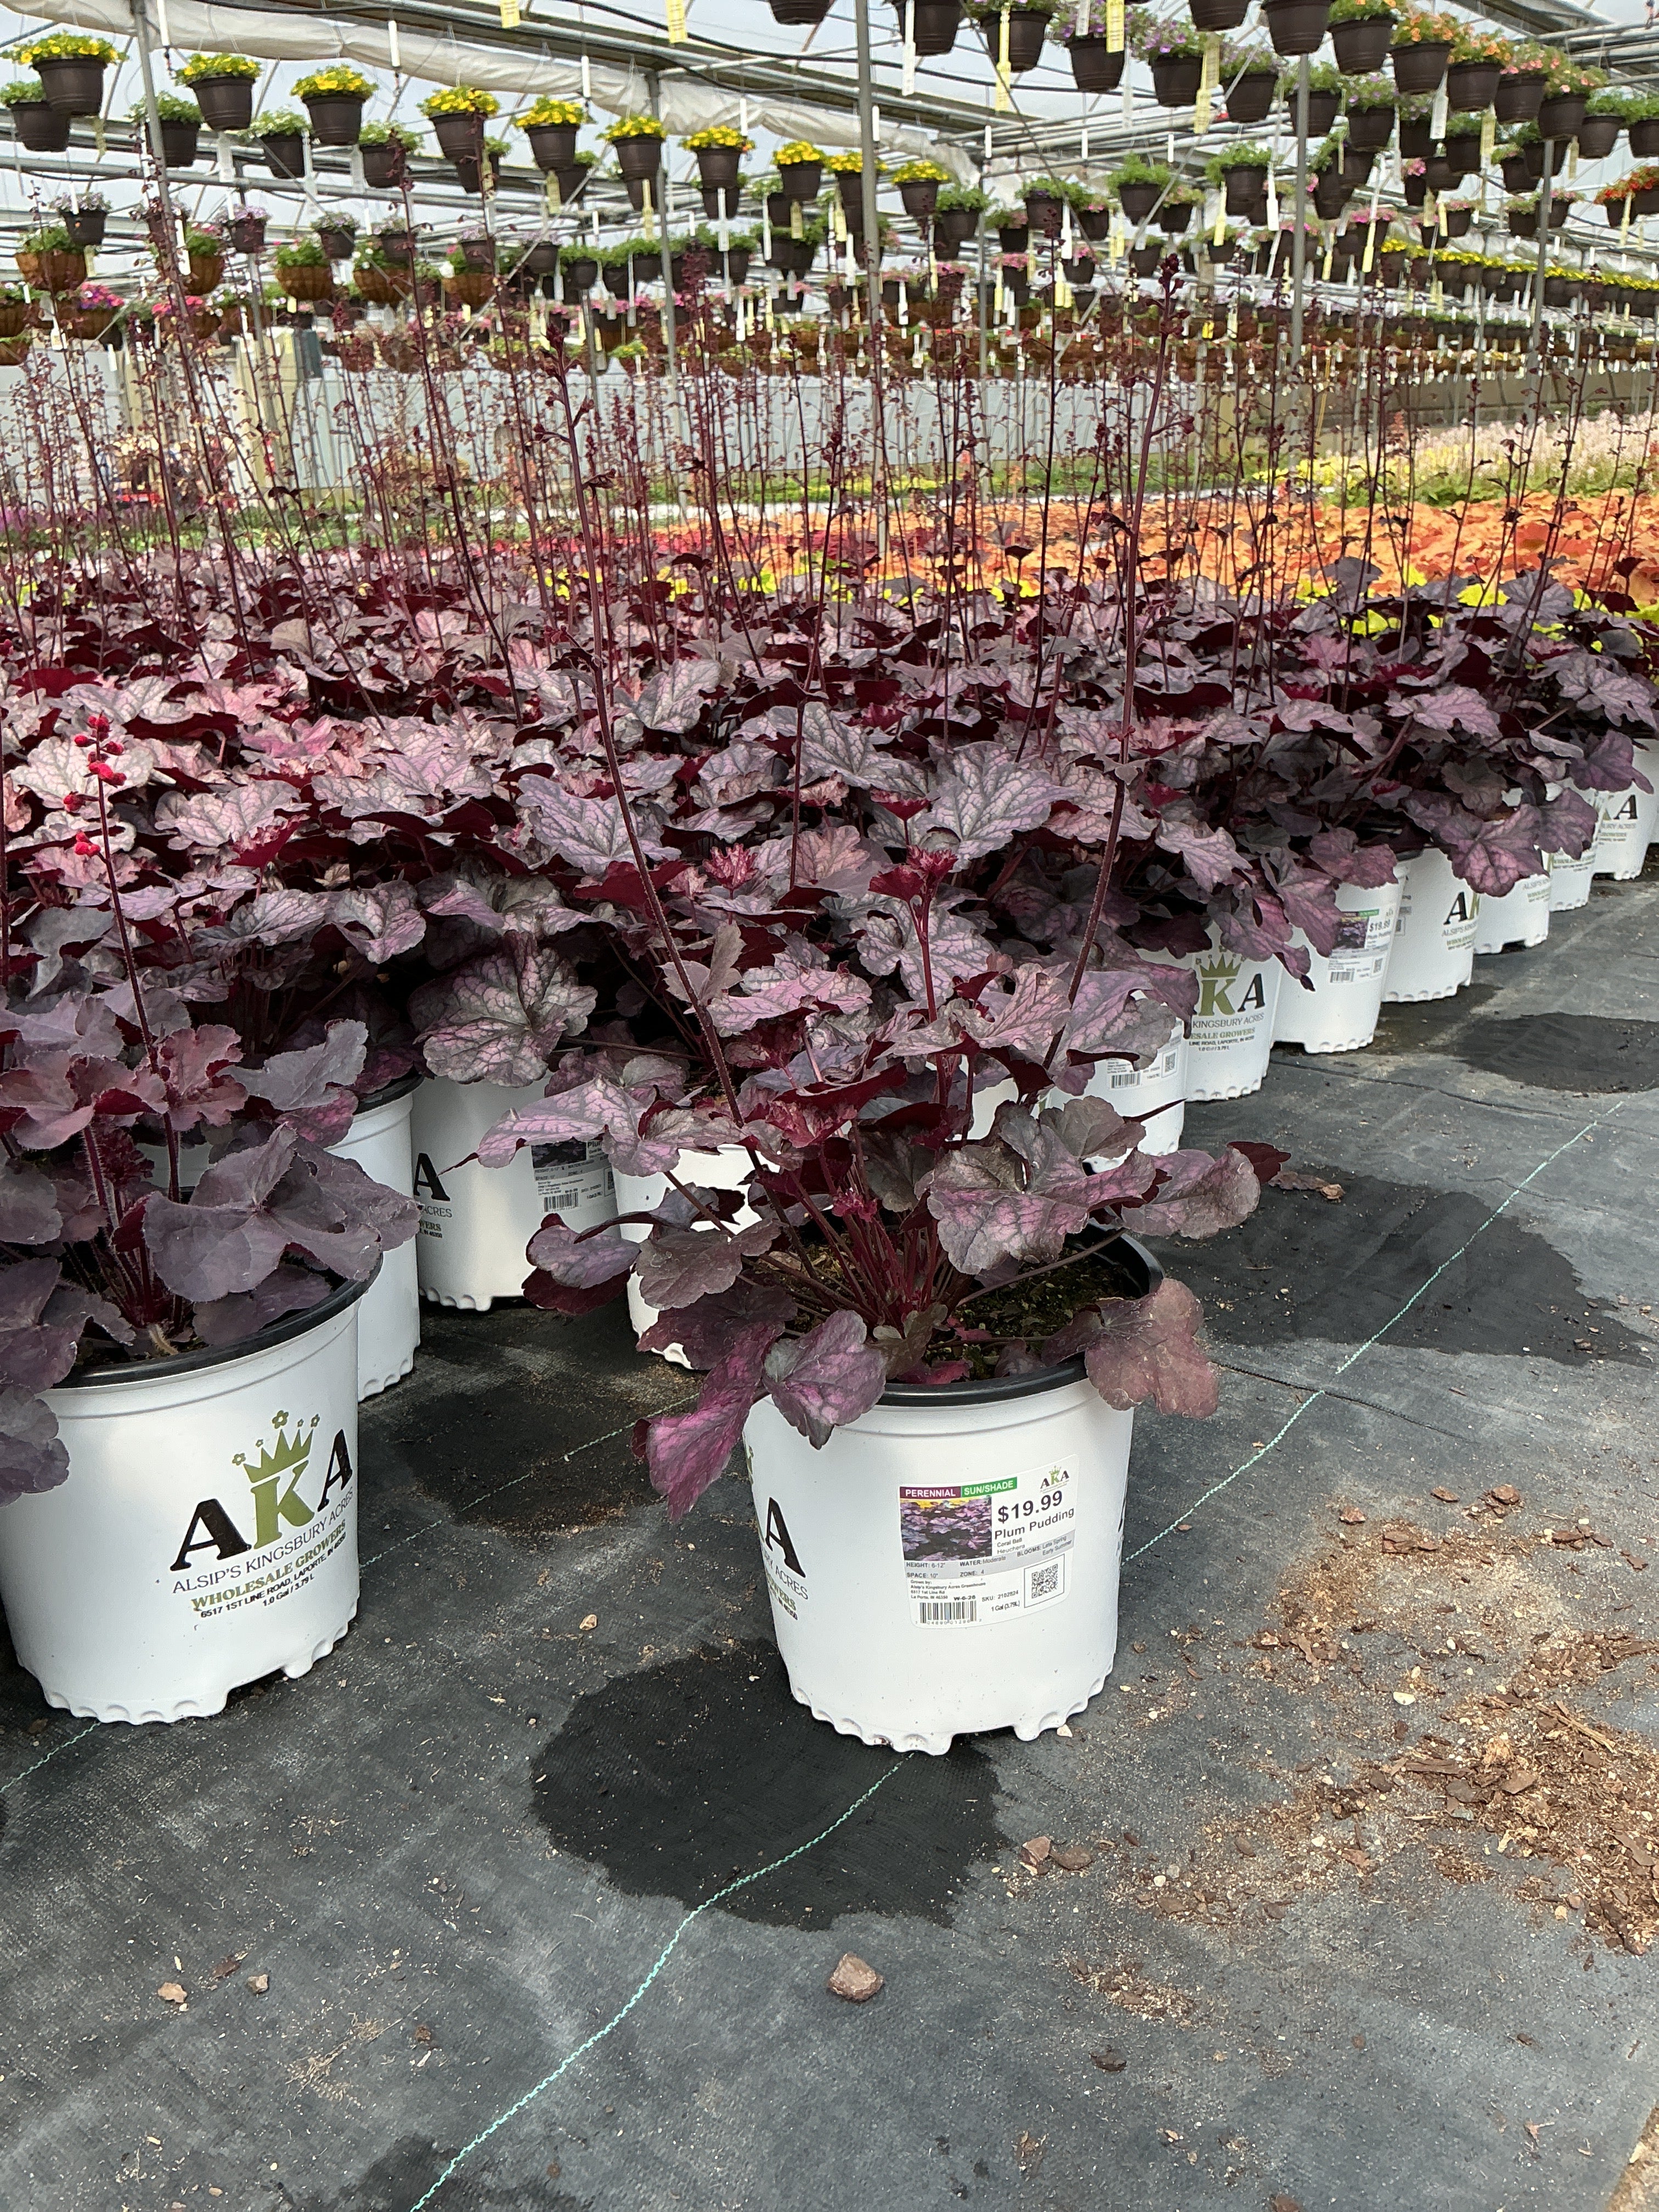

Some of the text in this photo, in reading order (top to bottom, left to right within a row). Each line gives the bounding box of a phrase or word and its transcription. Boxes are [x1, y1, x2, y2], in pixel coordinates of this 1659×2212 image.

[1193, 973, 1266, 1017] KA
[1193, 1018, 1243, 1029] KINGSBURY
[1243, 1013, 1265, 1024] ACRES
[1220, 1027, 1255, 1038] GROWERS
[170, 1429, 353, 1572] AKA
[905, 1480, 1013, 1497] PERENNIAL SUN/SHADE
[997, 1490, 1063, 1524] $19.99
[173, 1486, 353, 1594] ALSIP'S KINGSBURY ACRES
[995, 1508, 1074, 1540] Plum Pudding
[997, 1544, 1025, 1554] Heuchera
[1017, 1545, 1041, 1557] BLOOMS:
[1053, 1536, 1067, 1545] Spring
[191, 1519, 346, 1611] WHOLESALE GROWERS
[201, 1606, 223, 1618] 6517
[225, 1599, 244, 1611] 1ST
[245, 1592, 266, 1605] LINE
[267, 1578, 292, 1595] ROAD,
[263, 1597, 275, 1607] 1.0
[276, 1588, 289, 1600] Gal
[775, 1565, 809, 1600] ACRES
